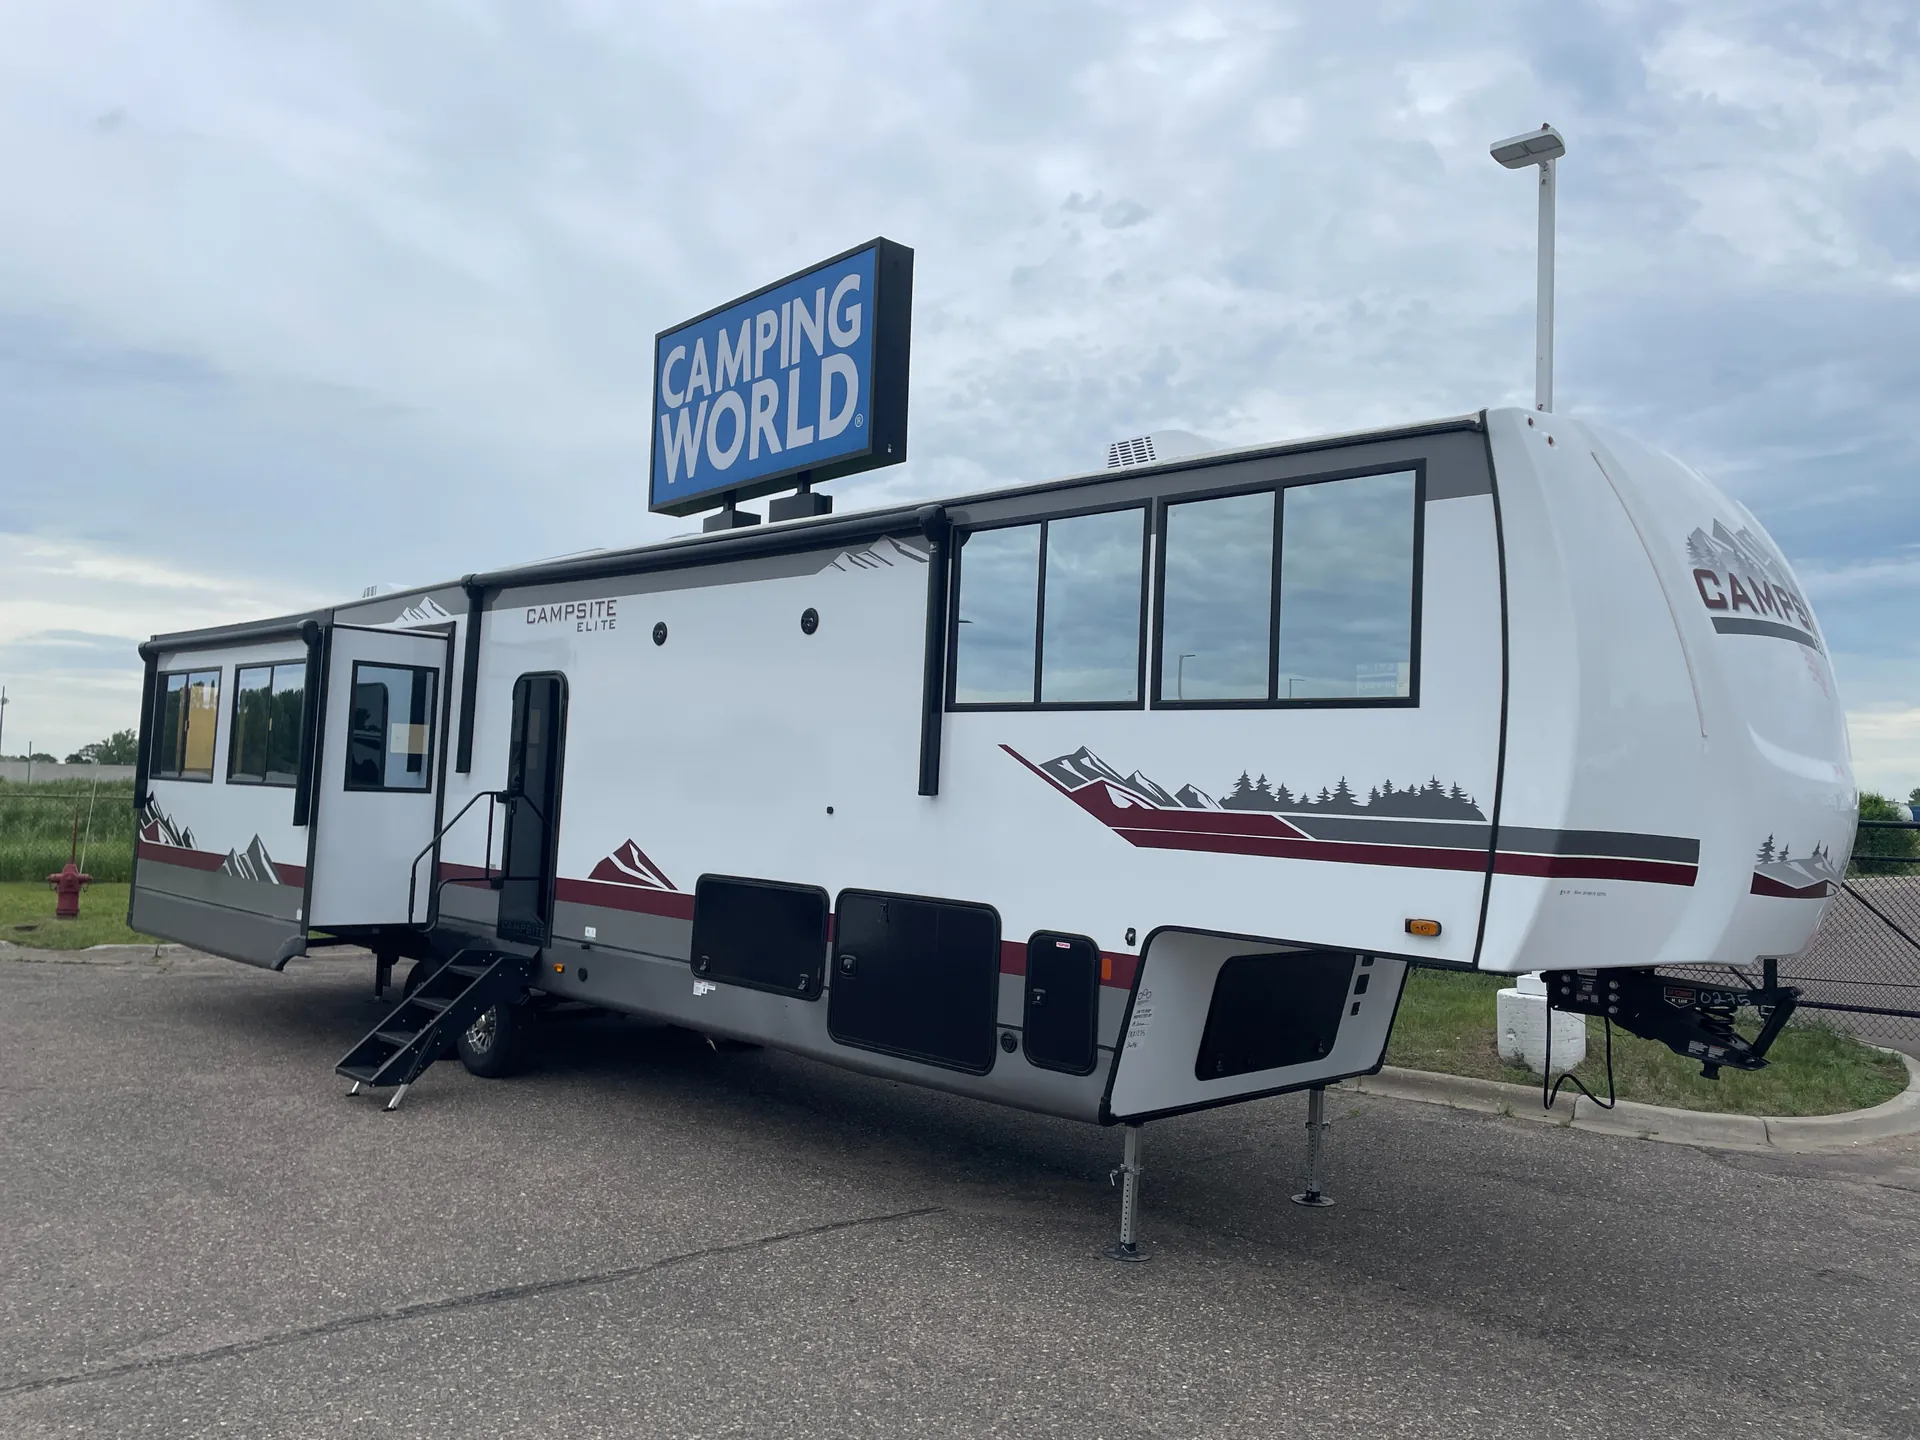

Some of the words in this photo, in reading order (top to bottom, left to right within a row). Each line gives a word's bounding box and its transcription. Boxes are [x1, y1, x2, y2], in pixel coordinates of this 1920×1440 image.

[661, 273, 862, 409] CAMPING
[660, 352, 860, 484] WORLD
[526, 599, 617, 624] CAMPSITE
[1693, 568, 1813, 632] CAMPS
[576, 619, 616, 632] ELITE
[1700, 991, 1751, 1006] 0275
